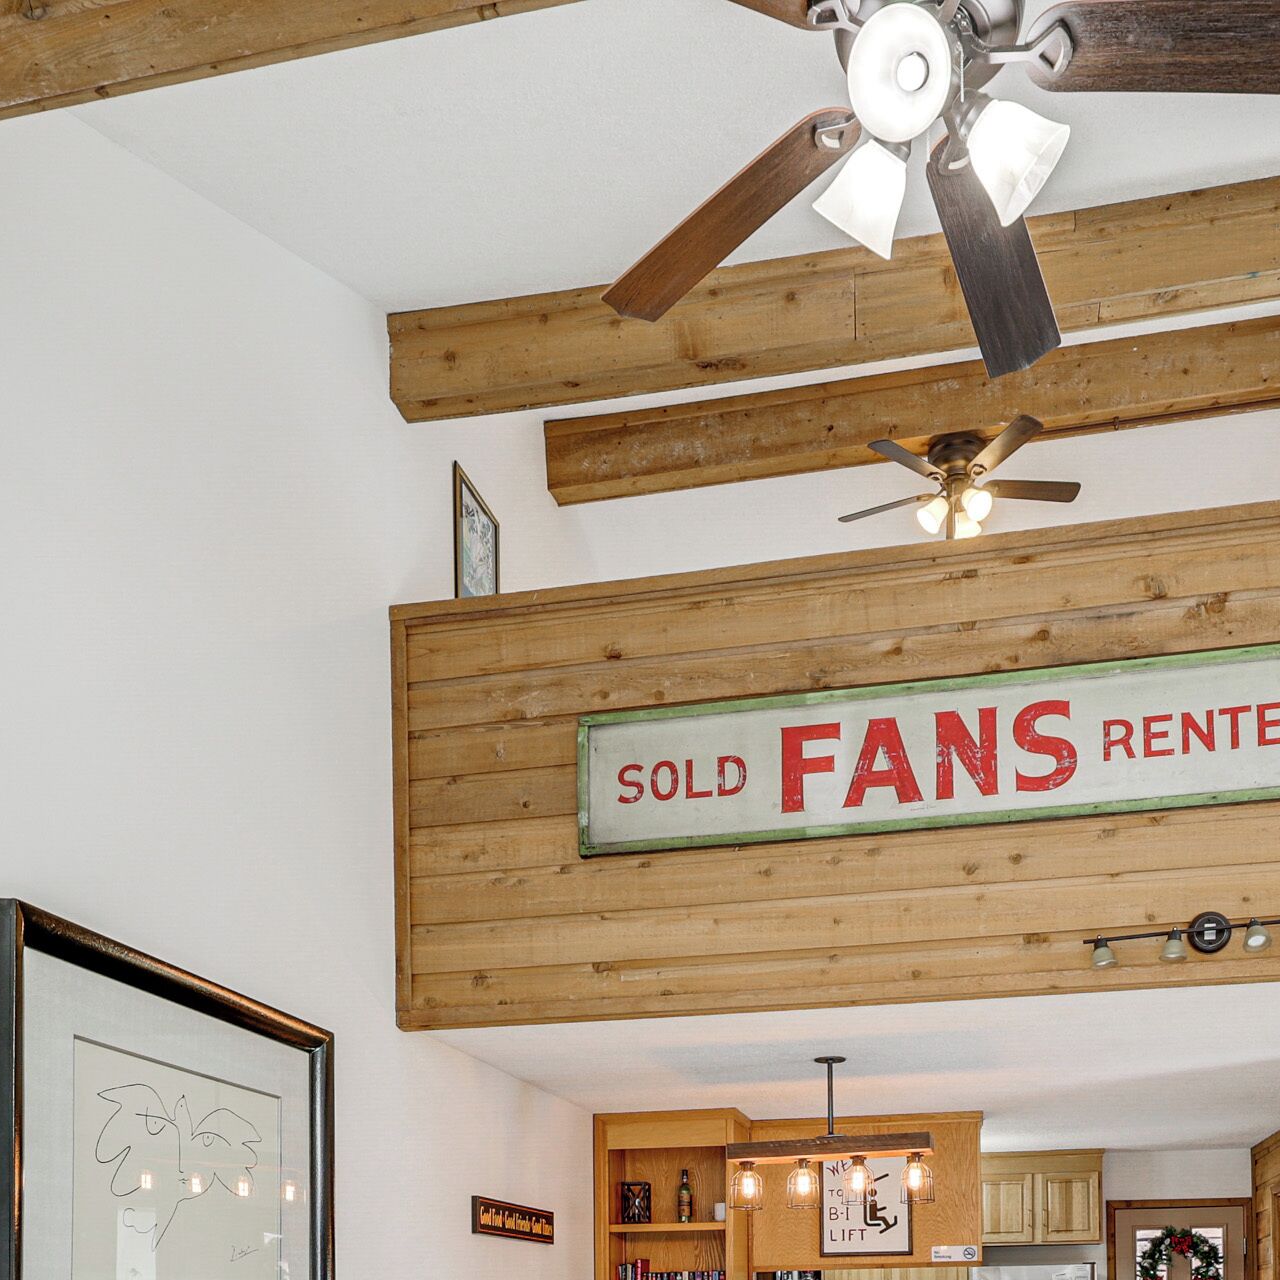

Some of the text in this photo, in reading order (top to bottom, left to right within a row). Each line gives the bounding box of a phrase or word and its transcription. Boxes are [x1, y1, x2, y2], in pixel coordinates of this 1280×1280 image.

[617, 755, 747, 804] SOLD
[780, 700, 1078, 813] FANS
[828, 1189, 843, 1197] TO
[830, 1228, 867, 1242] LIFT
